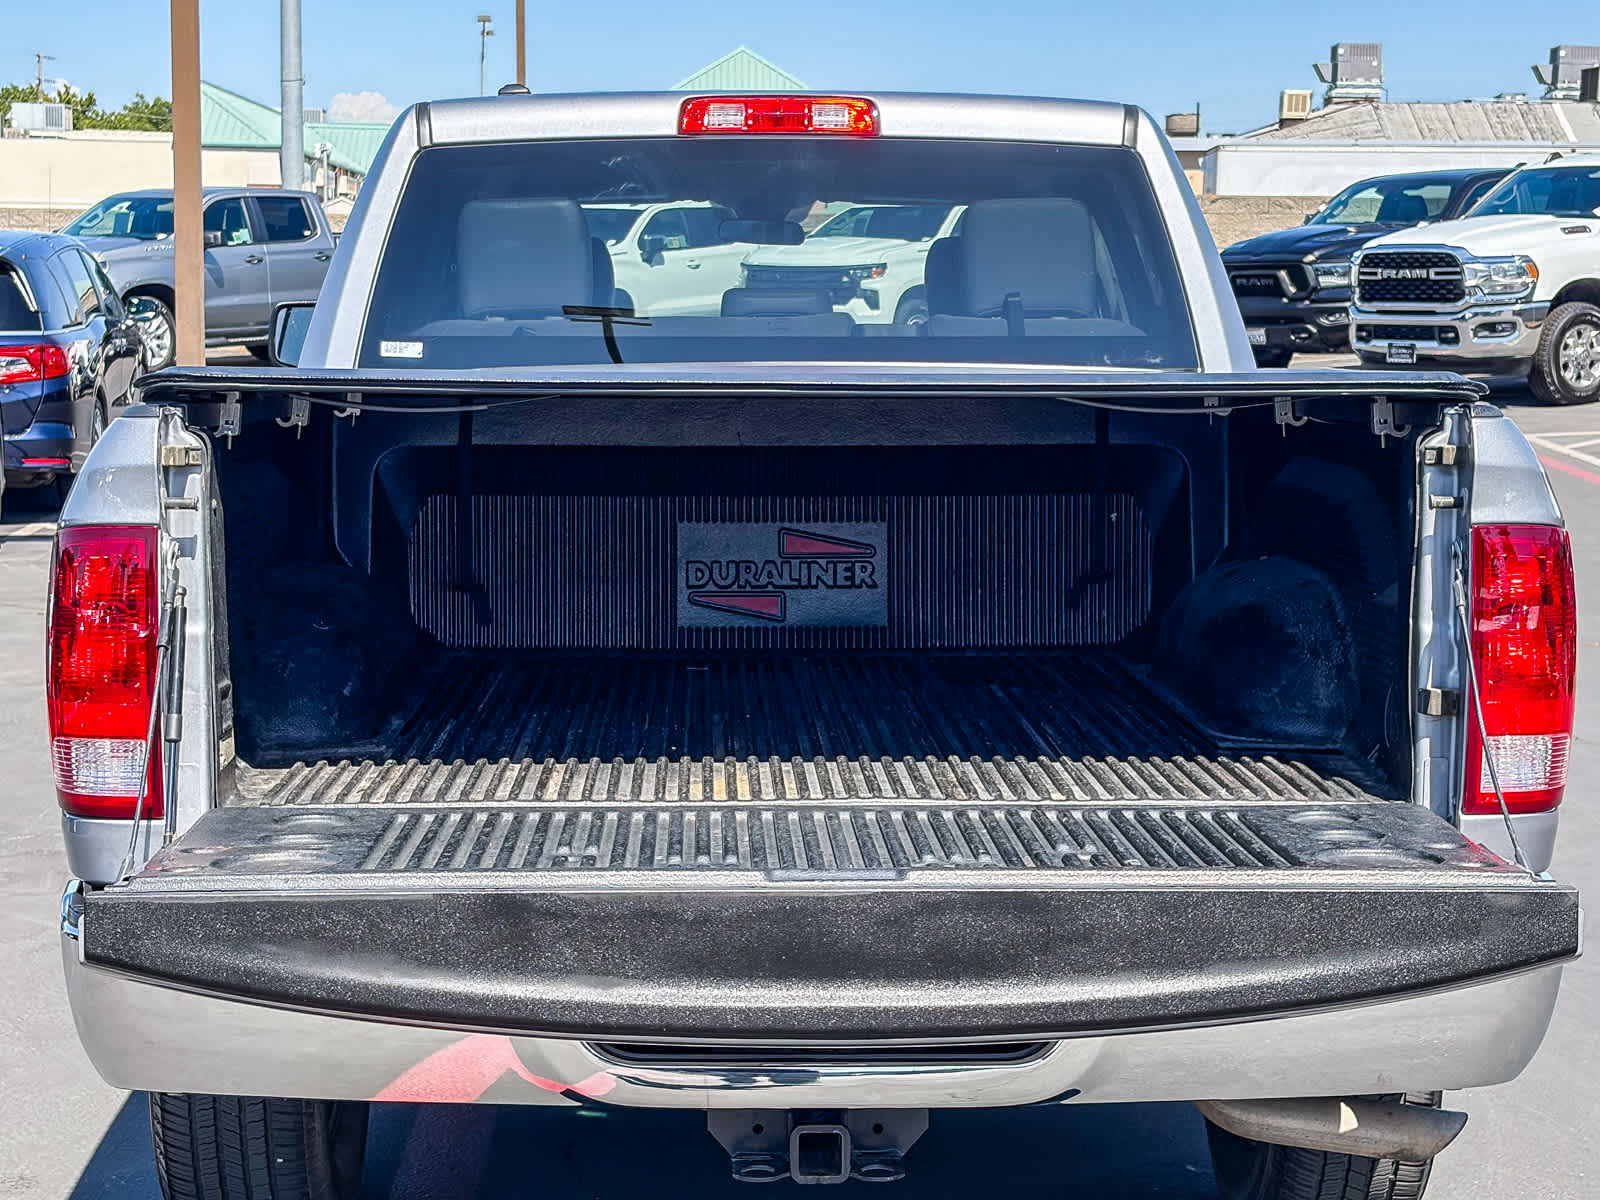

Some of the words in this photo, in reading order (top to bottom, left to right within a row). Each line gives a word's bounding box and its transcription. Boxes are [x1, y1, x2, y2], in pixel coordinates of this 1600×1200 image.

[1382, 268, 1427, 279] RAM
[1236, 278, 1274, 286] RAM
[686, 560, 877, 588] DURALINER
